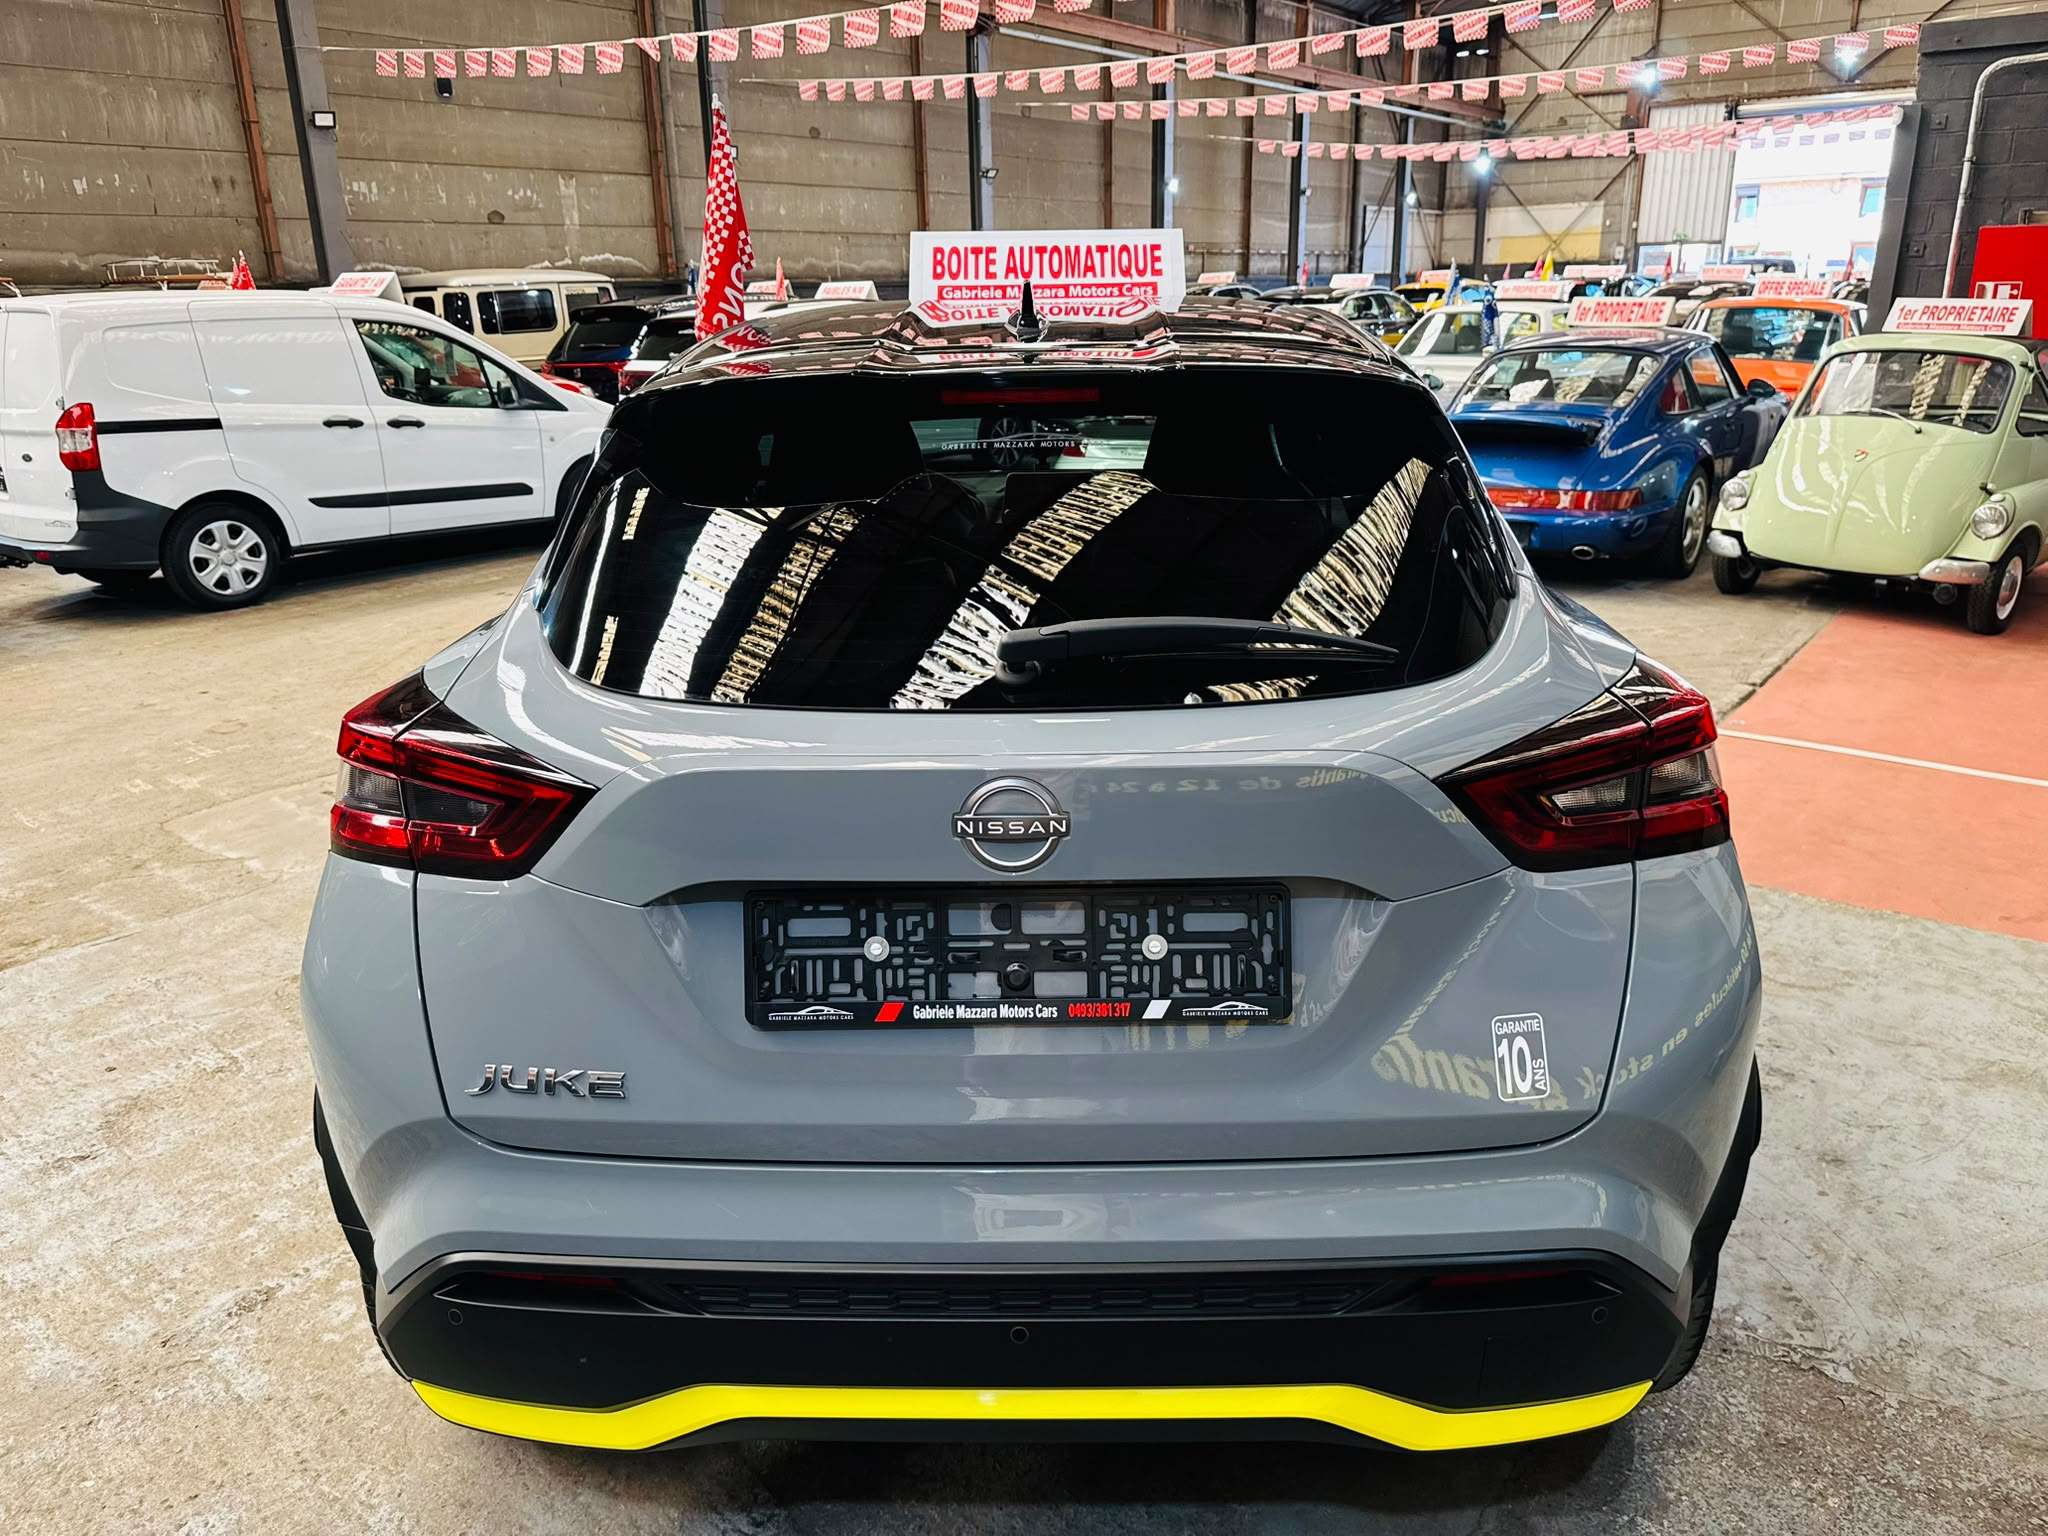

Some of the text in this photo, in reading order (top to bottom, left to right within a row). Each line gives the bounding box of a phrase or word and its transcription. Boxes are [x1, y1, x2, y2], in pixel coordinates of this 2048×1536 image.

[932, 244, 1163, 280] BOITE AUTOMATIQUE
[942, 284, 1153, 299] Gabriele Mzara Motors Cars
[1758, 281, 1827, 296] OFFRE SPECIALE
[1574, 301, 1666, 323] 1er PROPRIETAIRE
[1898, 305, 2019, 323] 1er PROPRIETAIRE
[993, 441, 1035, 449] MAZZARA
[1040, 440, 1076, 448] MOTORS
[957, 820, 1067, 834] NISSAN
[913, 1004, 954, 1019] Gabriele
[956, 1004, 998, 1018] Mazzara
[1000, 1004, 1034, 1018] Motors
[1035, 1003, 1058, 1018] Cars
[1495, 1019, 1541, 1035] GARANTIE
[1498, 1036, 1532, 1094] 10
[464, 1063, 627, 1099] JUKE
[1532, 1058, 1547, 1091] ANS
